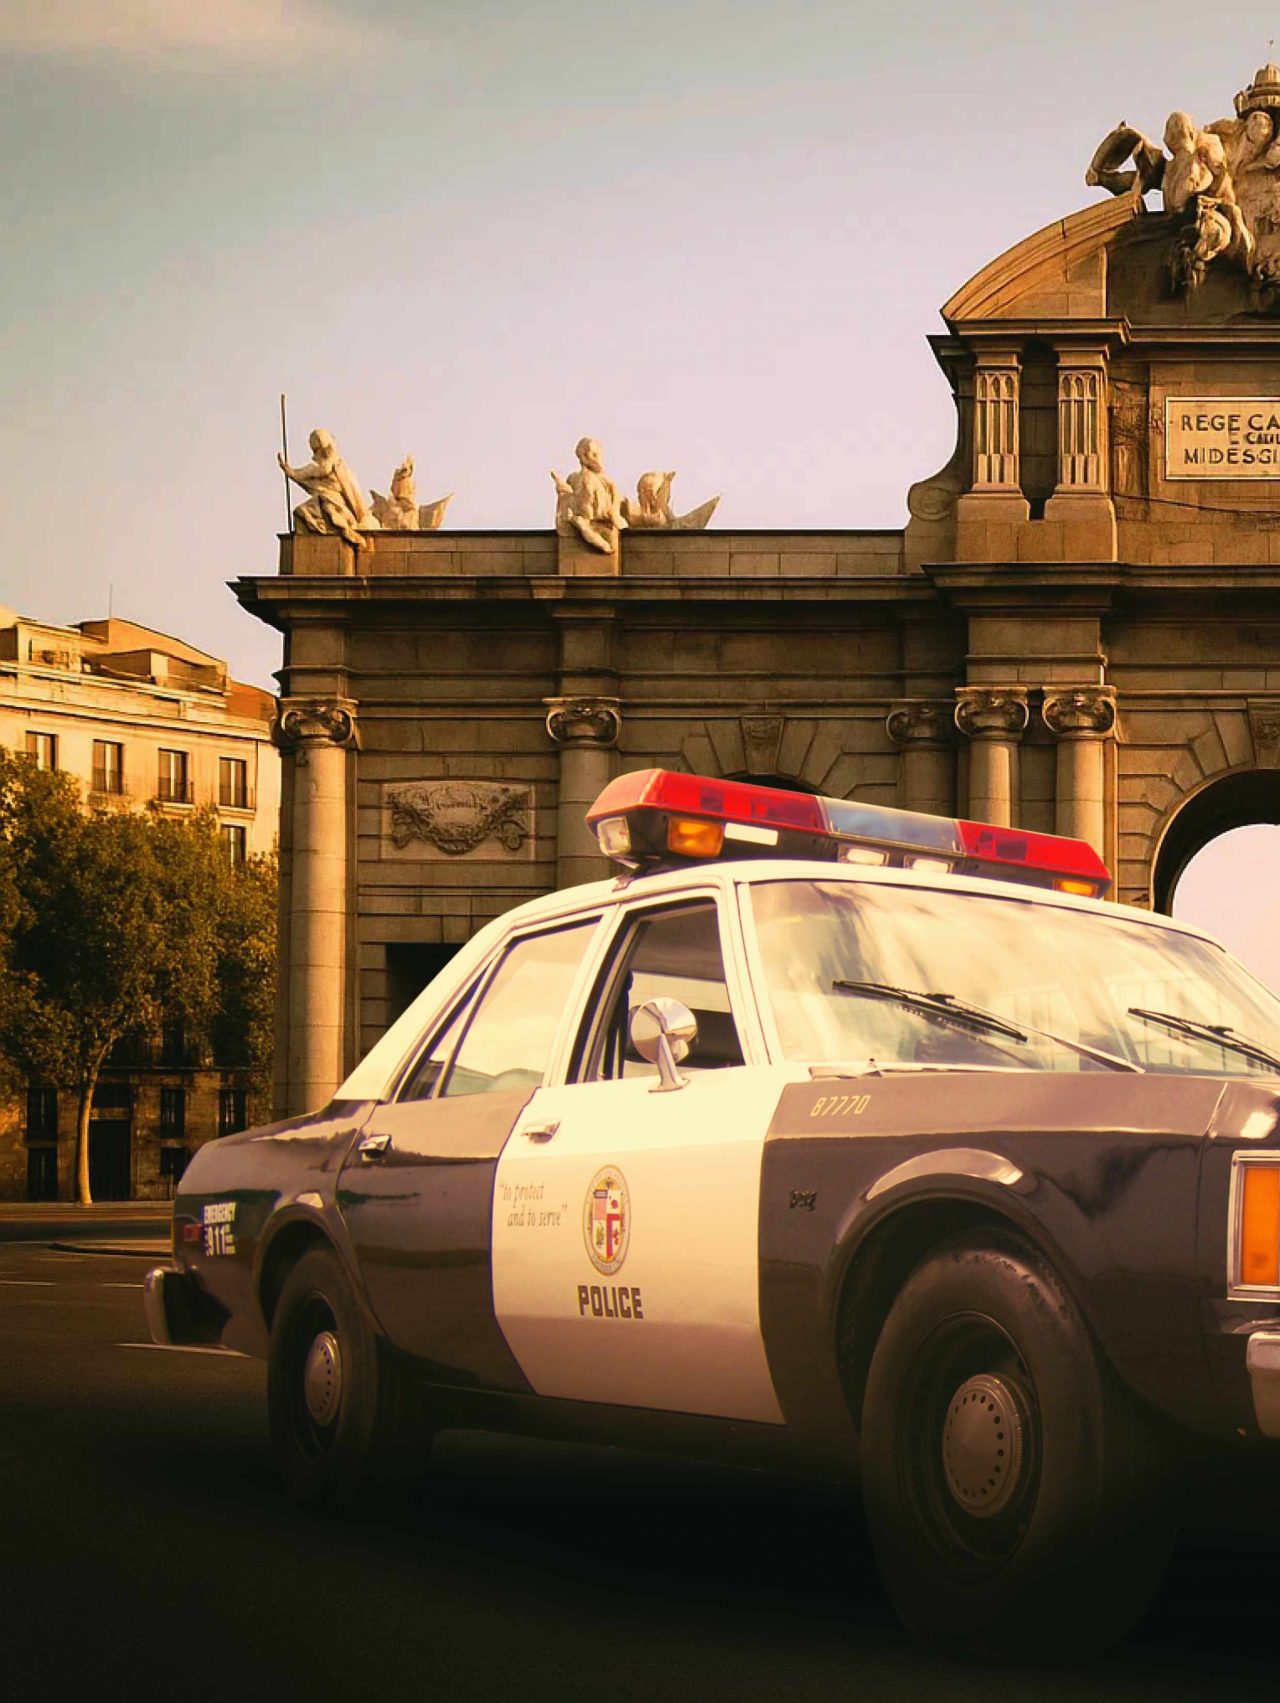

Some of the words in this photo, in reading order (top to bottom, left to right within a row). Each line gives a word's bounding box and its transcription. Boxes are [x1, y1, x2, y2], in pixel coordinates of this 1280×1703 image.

[809, 1094, 872, 1118] 87770
[513, 1180, 544, 1209] protect
[507, 1203, 525, 1227] and
[527, 1208, 537, 1227] to
[577, 1284, 644, 1320] POLICE
